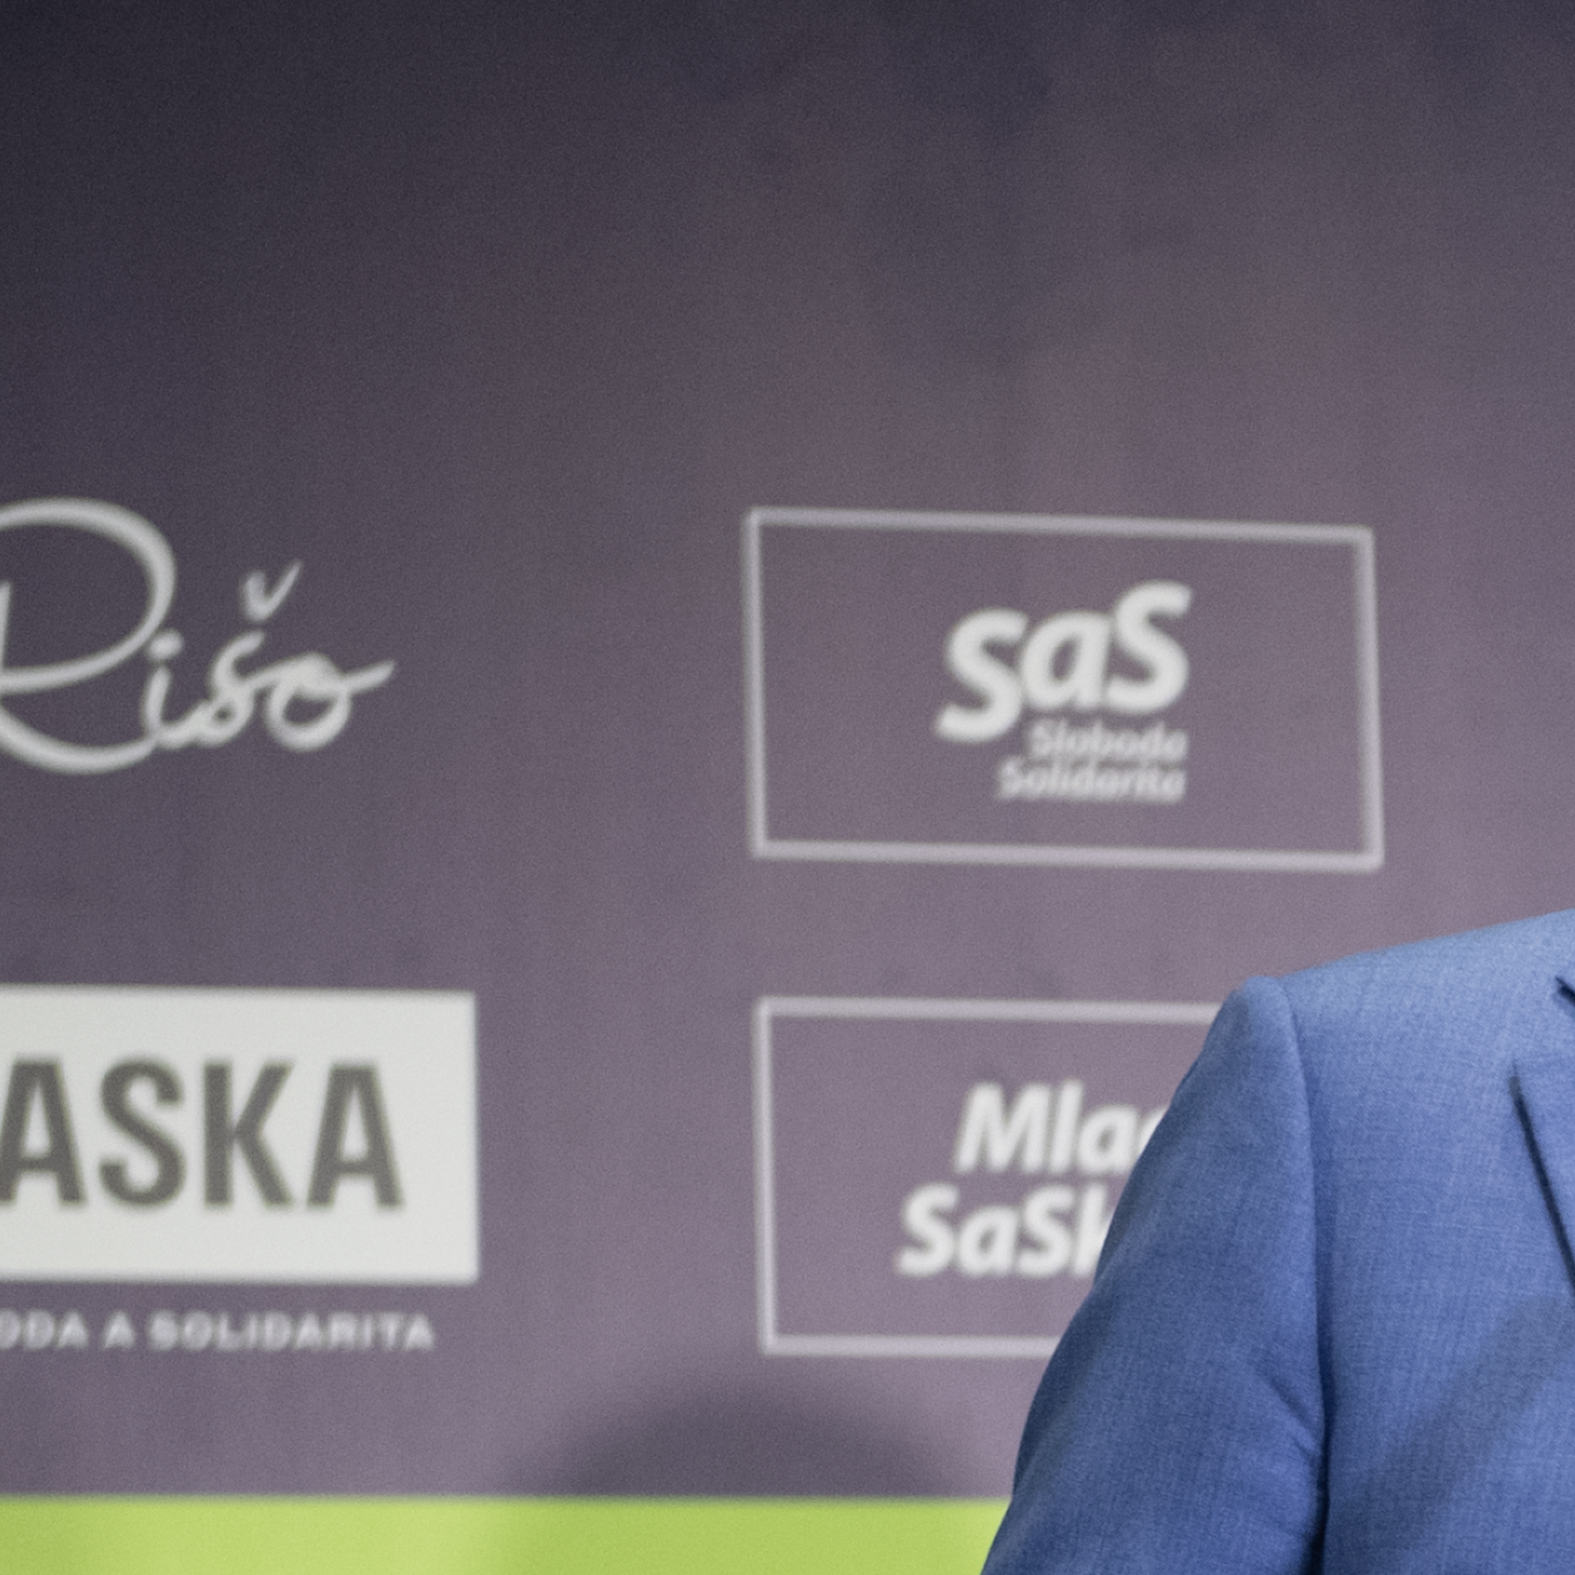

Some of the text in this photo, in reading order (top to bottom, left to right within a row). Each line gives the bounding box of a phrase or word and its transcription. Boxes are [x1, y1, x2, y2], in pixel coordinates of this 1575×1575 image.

[0, 1054, 404, 1214] ASKA
[954, 1078, 1168, 1176] Mla
[102, 1308, 136, 1350] A
[148, 1310, 436, 1354] SOLIDARITA
